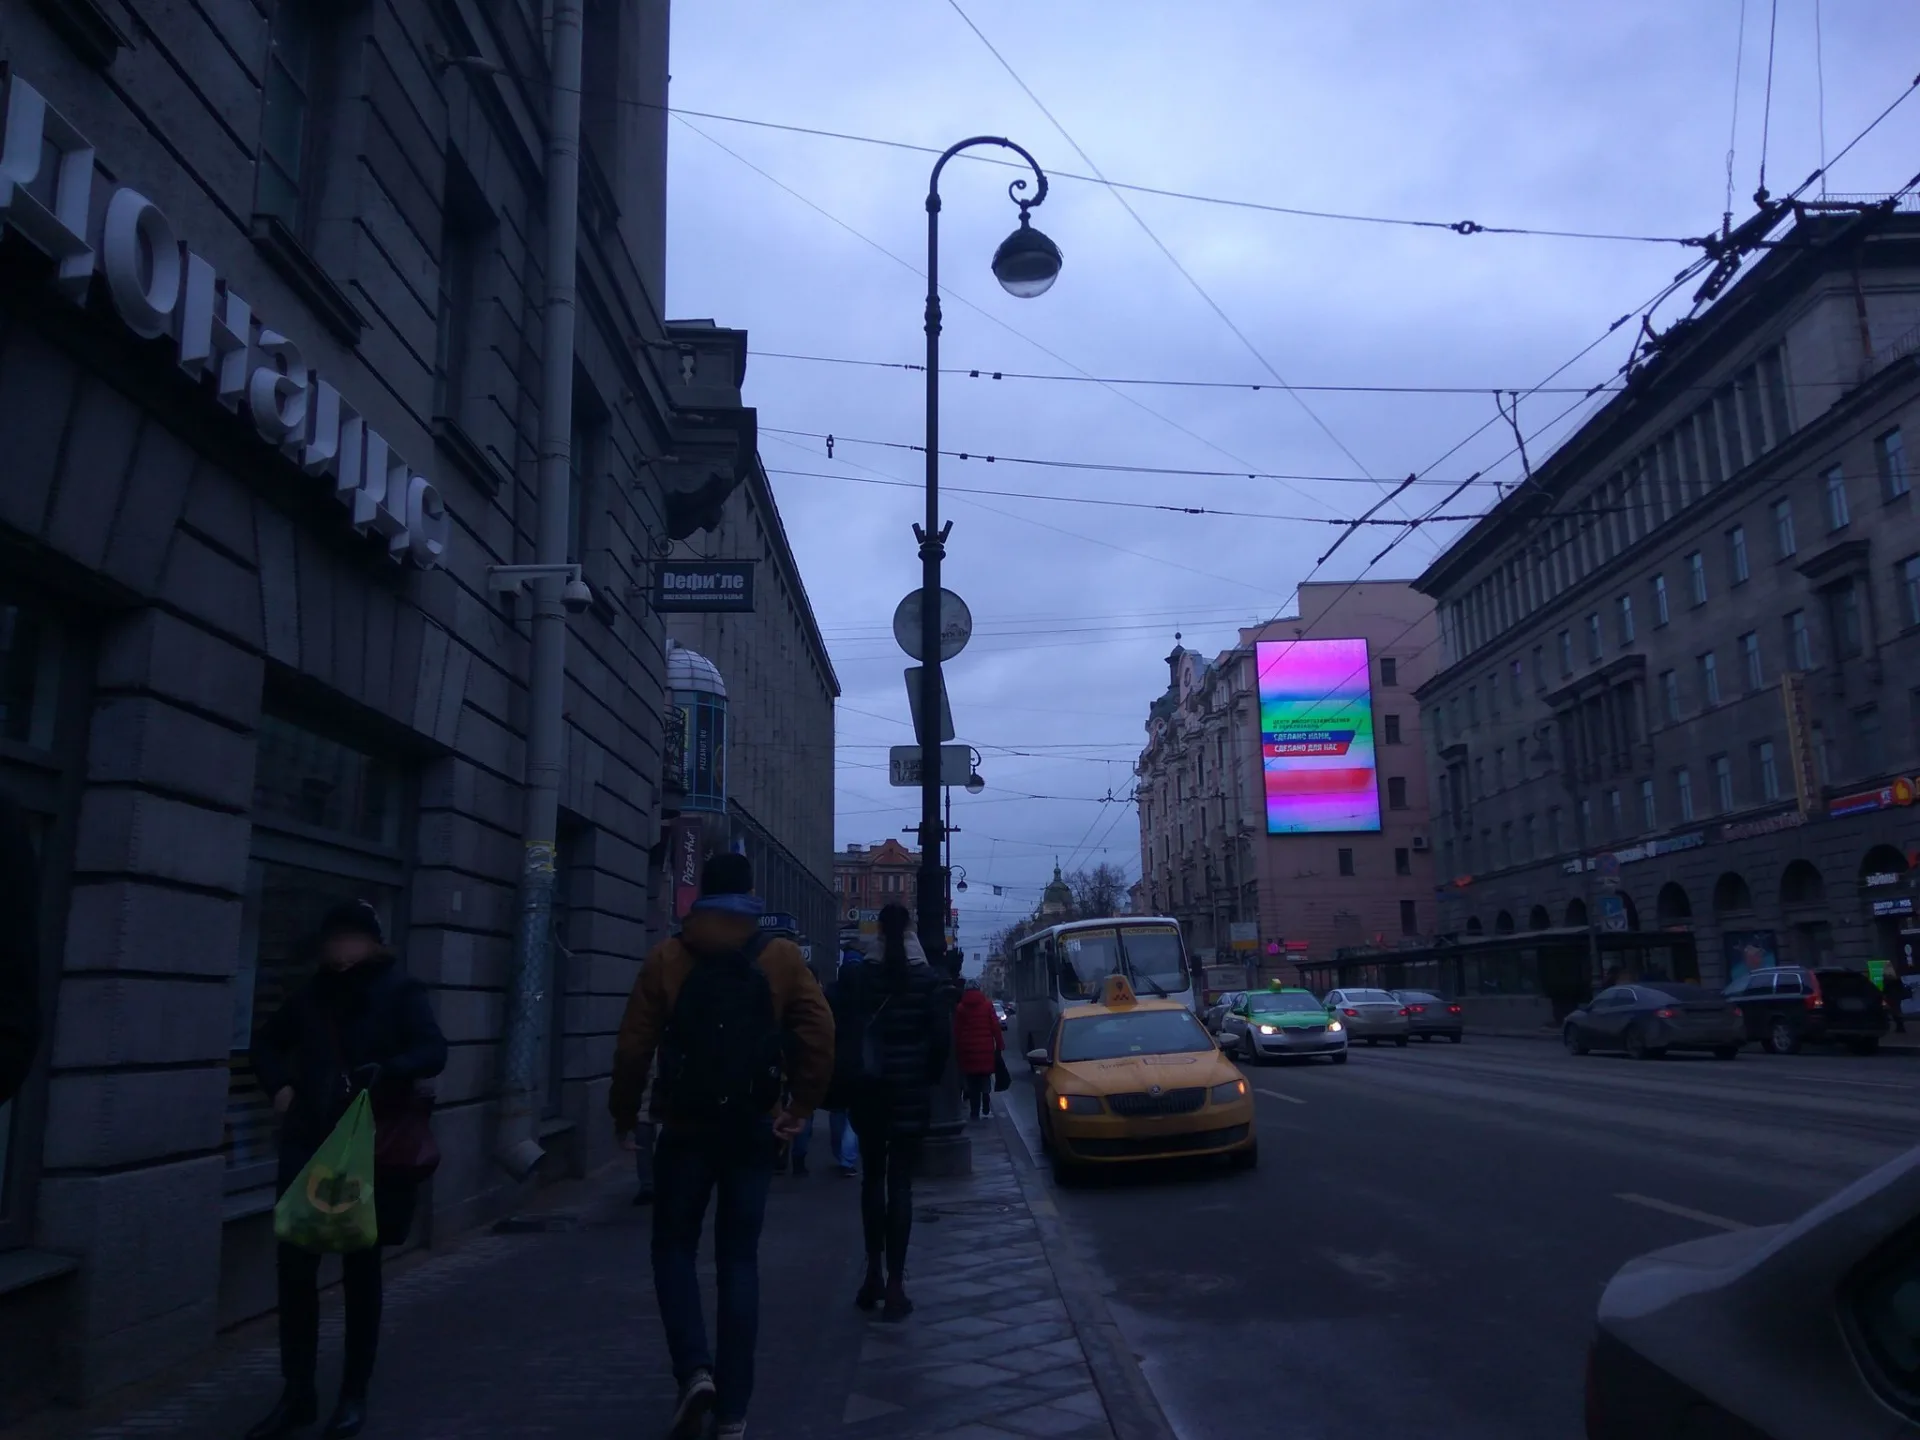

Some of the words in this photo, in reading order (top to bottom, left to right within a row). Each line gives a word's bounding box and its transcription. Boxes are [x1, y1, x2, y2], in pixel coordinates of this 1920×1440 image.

[1273, 733, 1307, 741] СДЕЛАНО
[1274, 744, 1306, 752] СДЕЛАНО
[1307, 743, 1322, 752] ДЛЯ
[1323, 743, 1338, 751] НАС
[684, 828, 696, 853] Hut
[682, 854, 696, 886] Pizza
